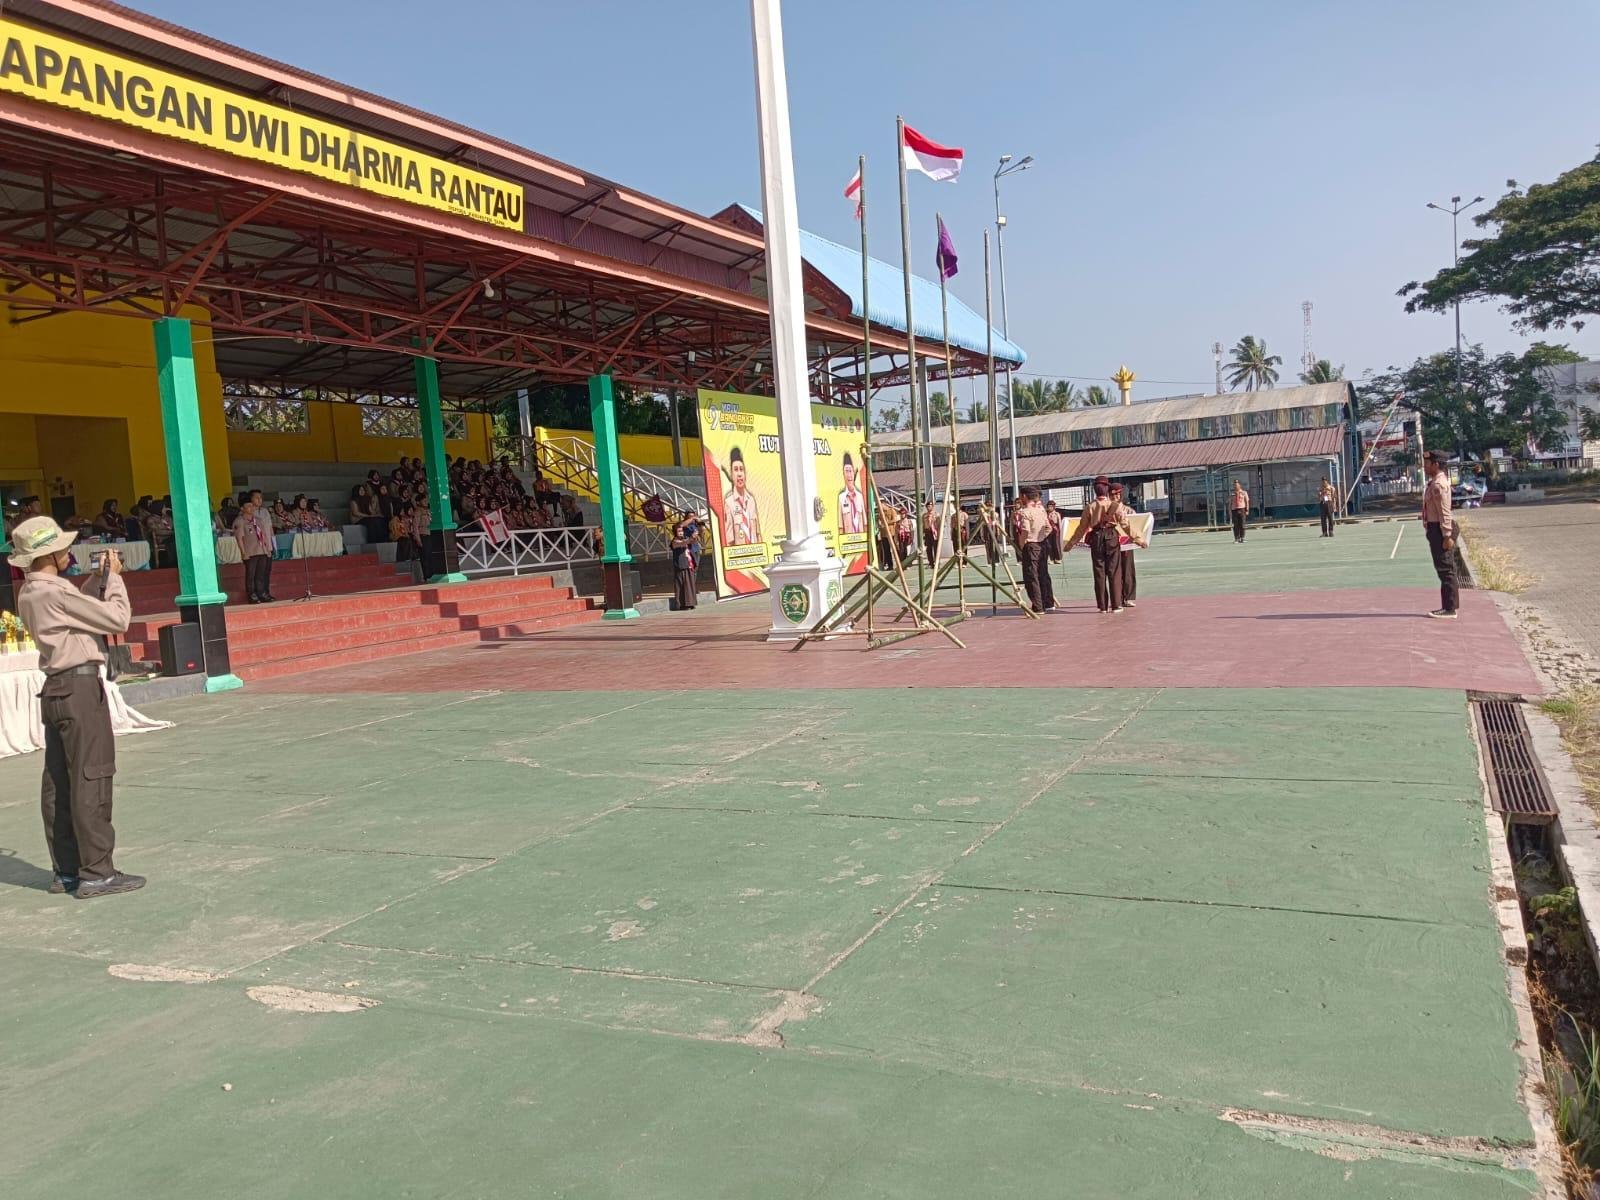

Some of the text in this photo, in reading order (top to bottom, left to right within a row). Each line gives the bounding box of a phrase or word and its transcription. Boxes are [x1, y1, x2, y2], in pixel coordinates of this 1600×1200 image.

[0, 38, 520, 222] APANGAN DWI DHARMA RANTAU
